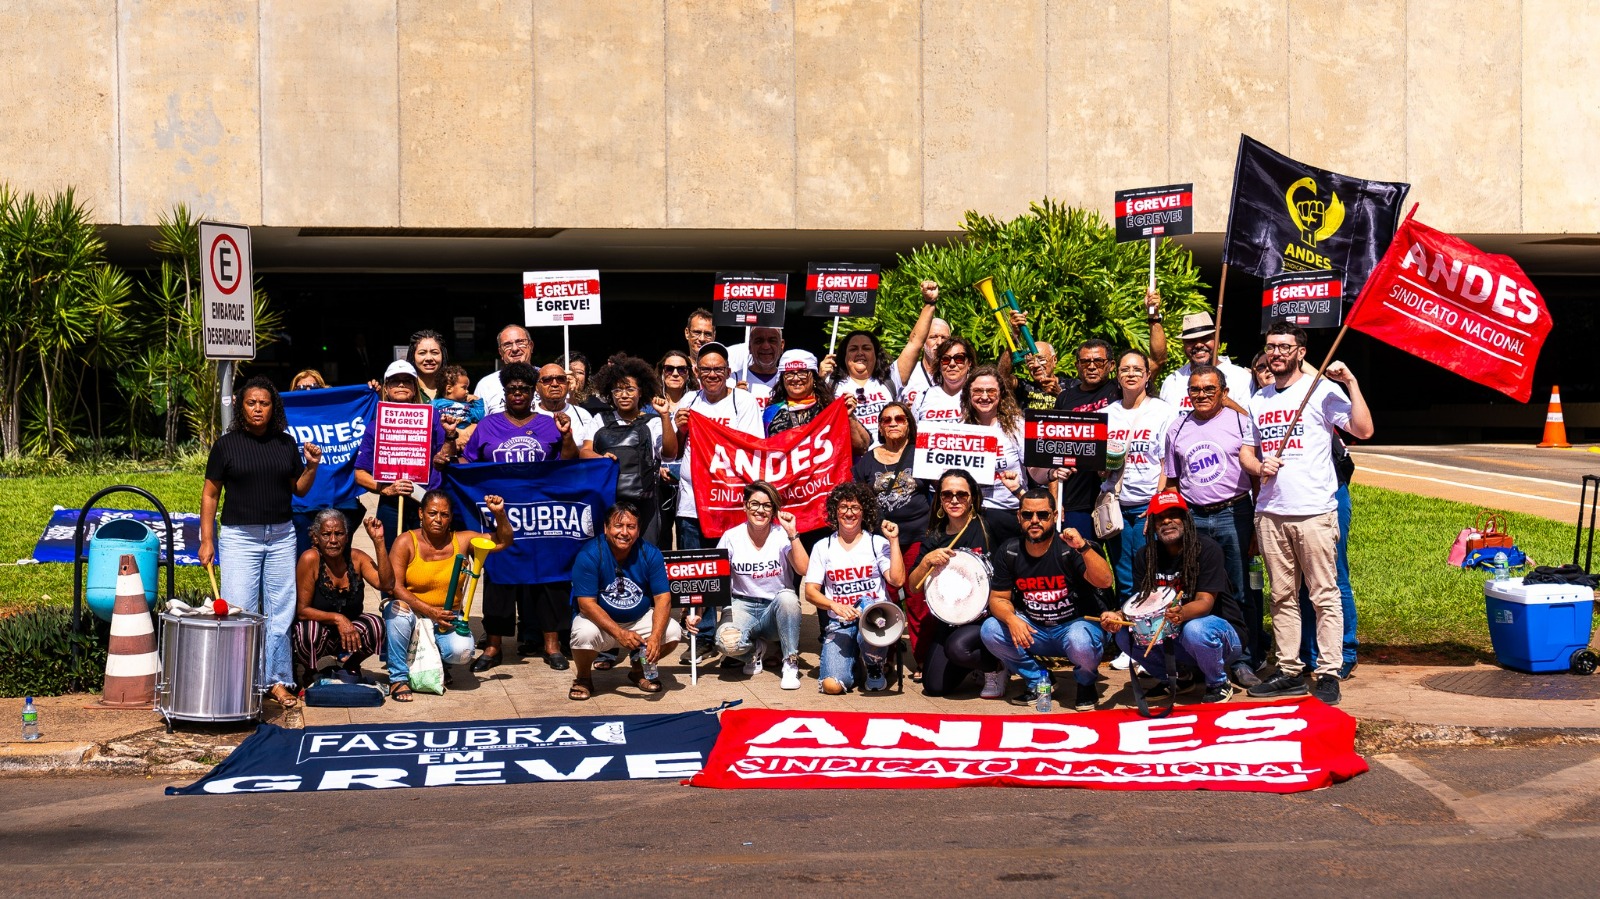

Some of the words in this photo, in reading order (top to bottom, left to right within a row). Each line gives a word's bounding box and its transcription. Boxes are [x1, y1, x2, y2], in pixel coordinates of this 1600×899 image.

[1126, 198, 1133, 213] É
[1134, 194, 1180, 211] GREVE!
[1134, 210, 1182, 226] GREVE!
[220, 247, 232, 281] E
[1284, 242, 1332, 270] ANDES
[818, 272, 824, 288] É
[825, 276, 868, 288] GREVE!
[1401, 242, 1539, 324] ANDES
[544, 282, 588, 297] GREVE!
[724, 282, 730, 298] É
[730, 284, 774, 297] GREVE!
[824, 290, 868, 304] GREVE!
[1272, 286, 1279, 302] É
[1280, 283, 1328, 298] GREVE!
[212, 302, 245, 321] EMBARQUE
[536, 297, 543, 311] É
[544, 298, 590, 311] GREVE!
[730, 300, 776, 314] GREVE!
[1279, 300, 1330, 314] GREVE!
[1388, 284, 1458, 326] SINDICATO
[1460, 317, 1524, 356] NACIONAL
[207, 328, 252, 347] DESEMBARQUE
[925, 410, 961, 418] GREV
[1037, 420, 1044, 437] É
[1045, 424, 1094, 438] GREVE!
[936, 436, 984, 450] GREVE!
[1044, 440, 1096, 456] GREVE!
[332, 453, 350, 464] CUT
[710, 424, 834, 482] ANDES
[926, 448, 934, 463] É
[935, 453, 984, 468] GREVE!
[1190, 453, 1219, 474] SIM
[480, 505, 580, 532] FSUBRA
[670, 562, 718, 577] GREVE!
[826, 566, 873, 582] GREVE
[670, 578, 720, 594] GREVE!
[1016, 575, 1066, 590] GREVE
[744, 704, 1308, 752] ANDES
[309, 726, 588, 753] FASUBRA
[418, 750, 484, 764] EM
[203, 752, 702, 794] GREVE
[735, 758, 1018, 776] SINDICATO
[1034, 760, 1320, 777] NACIONAL
